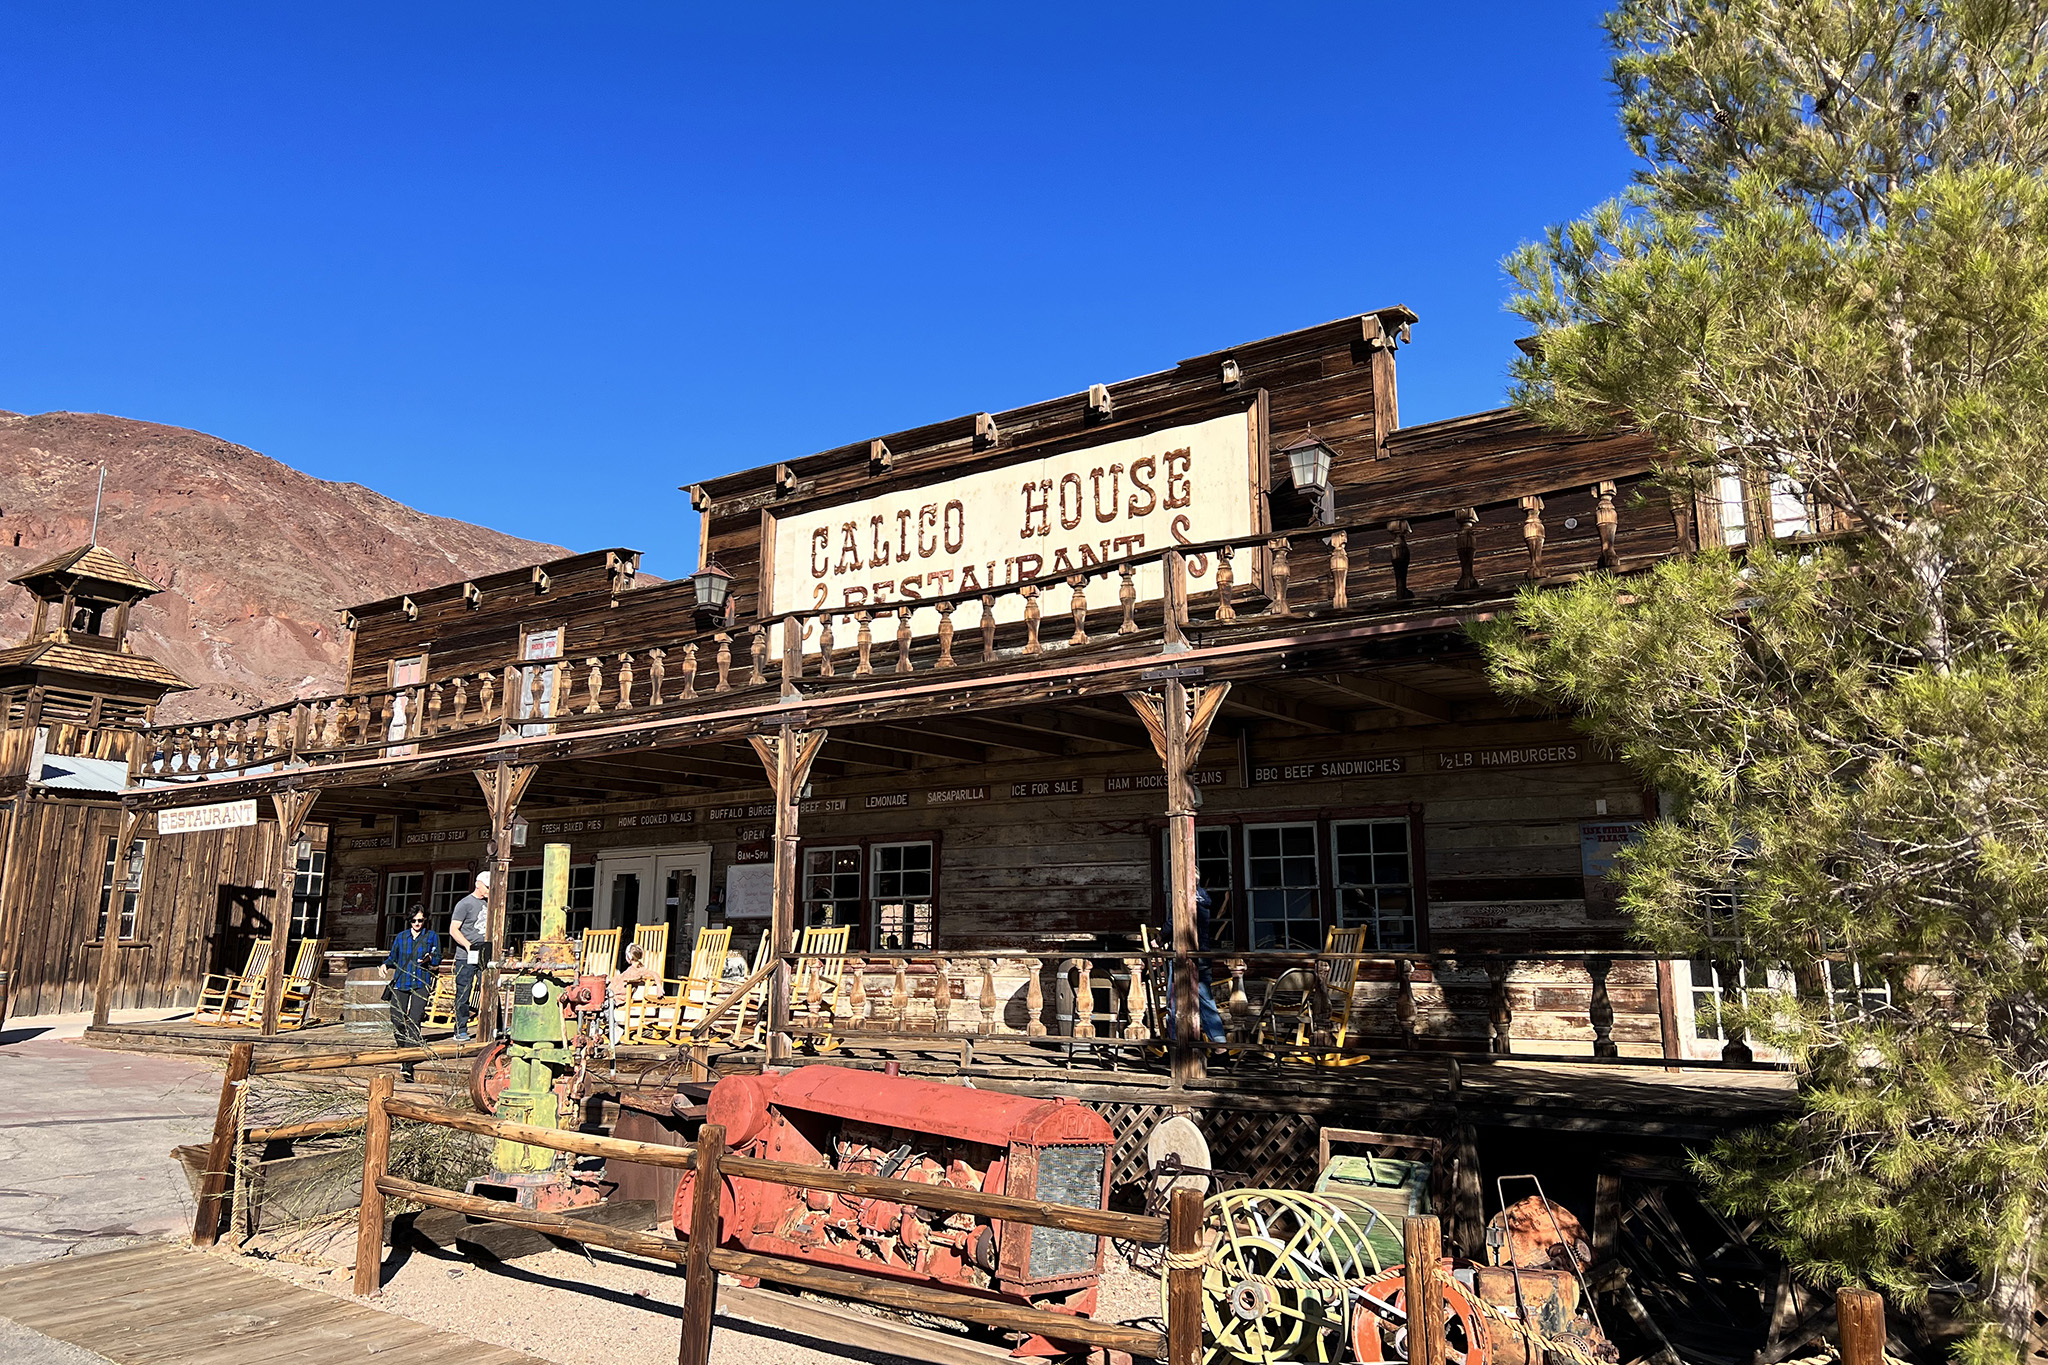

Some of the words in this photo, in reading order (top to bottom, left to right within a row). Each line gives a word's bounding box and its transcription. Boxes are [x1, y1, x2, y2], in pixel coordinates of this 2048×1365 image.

[811, 498, 965, 579] CALICO
[1020, 446, 1191, 539] HOUSE
[1481, 746, 1577, 766] HAMBURGERS
[1284, 765, 1313, 778] BEEF
[1320, 758, 1401, 776] SANDWICHES
[1108, 777, 1130, 791] HAM
[1193, 771, 1222, 784] EANS
[927, 788, 984, 803] SARSAPARILLA
[1011, 784, 1026, 797] ICE
[1031, 783, 1049, 795] FOR
[1054, 780, 1078, 793] SALE
[800, 801, 820, 813] BEEF
[825, 800, 846, 811] STEW
[865, 794, 908, 808] LEMONADE
[161, 804, 253, 830] RESTAURANT
[618, 816, 637, 827] HOME
[640, 813, 668, 825] COOKED
[670, 811, 692, 823] MEALS
[710, 807, 743, 820] BUFFALO
[480, 829, 490, 839] ICE
[541, 823, 561, 834] FRESH
[563, 821, 584, 832] BAKED
[586, 820, 602, 830] PIES
[406, 833, 429, 843] CHICKEN
[430, 831, 446, 841] FRIED
[448, 830, 467, 840] STEAK
[742, 829, 765, 840] OPEN
[351, 838, 379, 848] FIREHOUSE
